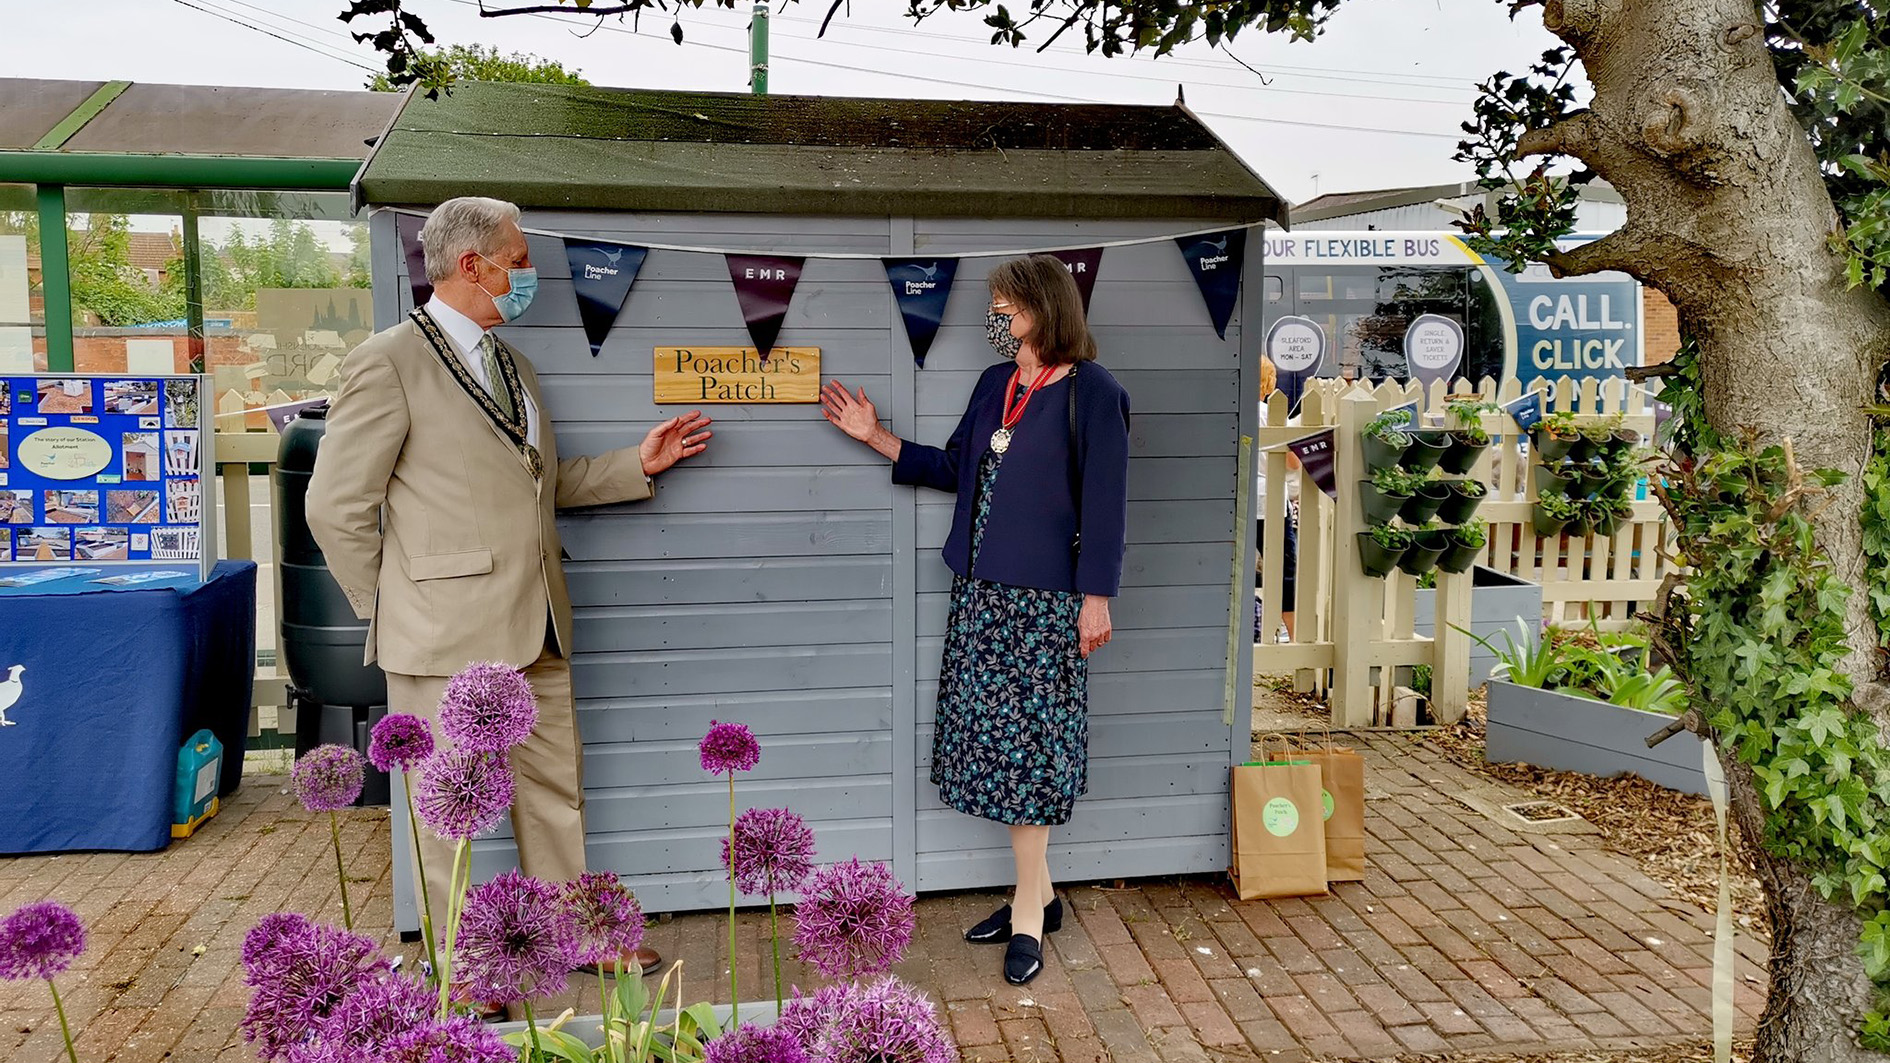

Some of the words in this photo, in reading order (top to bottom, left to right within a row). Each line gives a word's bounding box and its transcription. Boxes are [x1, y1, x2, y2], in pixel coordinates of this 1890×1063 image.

[1304, 239, 1396, 258] FLEXIBLE
[1404, 239, 1440, 257] BUS
[1200, 255, 1229, 264] Poacher
[585, 264, 618, 276] Poacher
[1063, 262, 1086, 273] MR
[1200, 263, 1217, 271] Line
[585, 272, 602, 280] Line
[905, 280, 936, 289] Poacher
[905, 287, 922, 295] Line
[1529, 294, 1633, 331] CALL.
[673, 349, 800, 374] Poacher's
[698, 376, 777, 400] Patch
